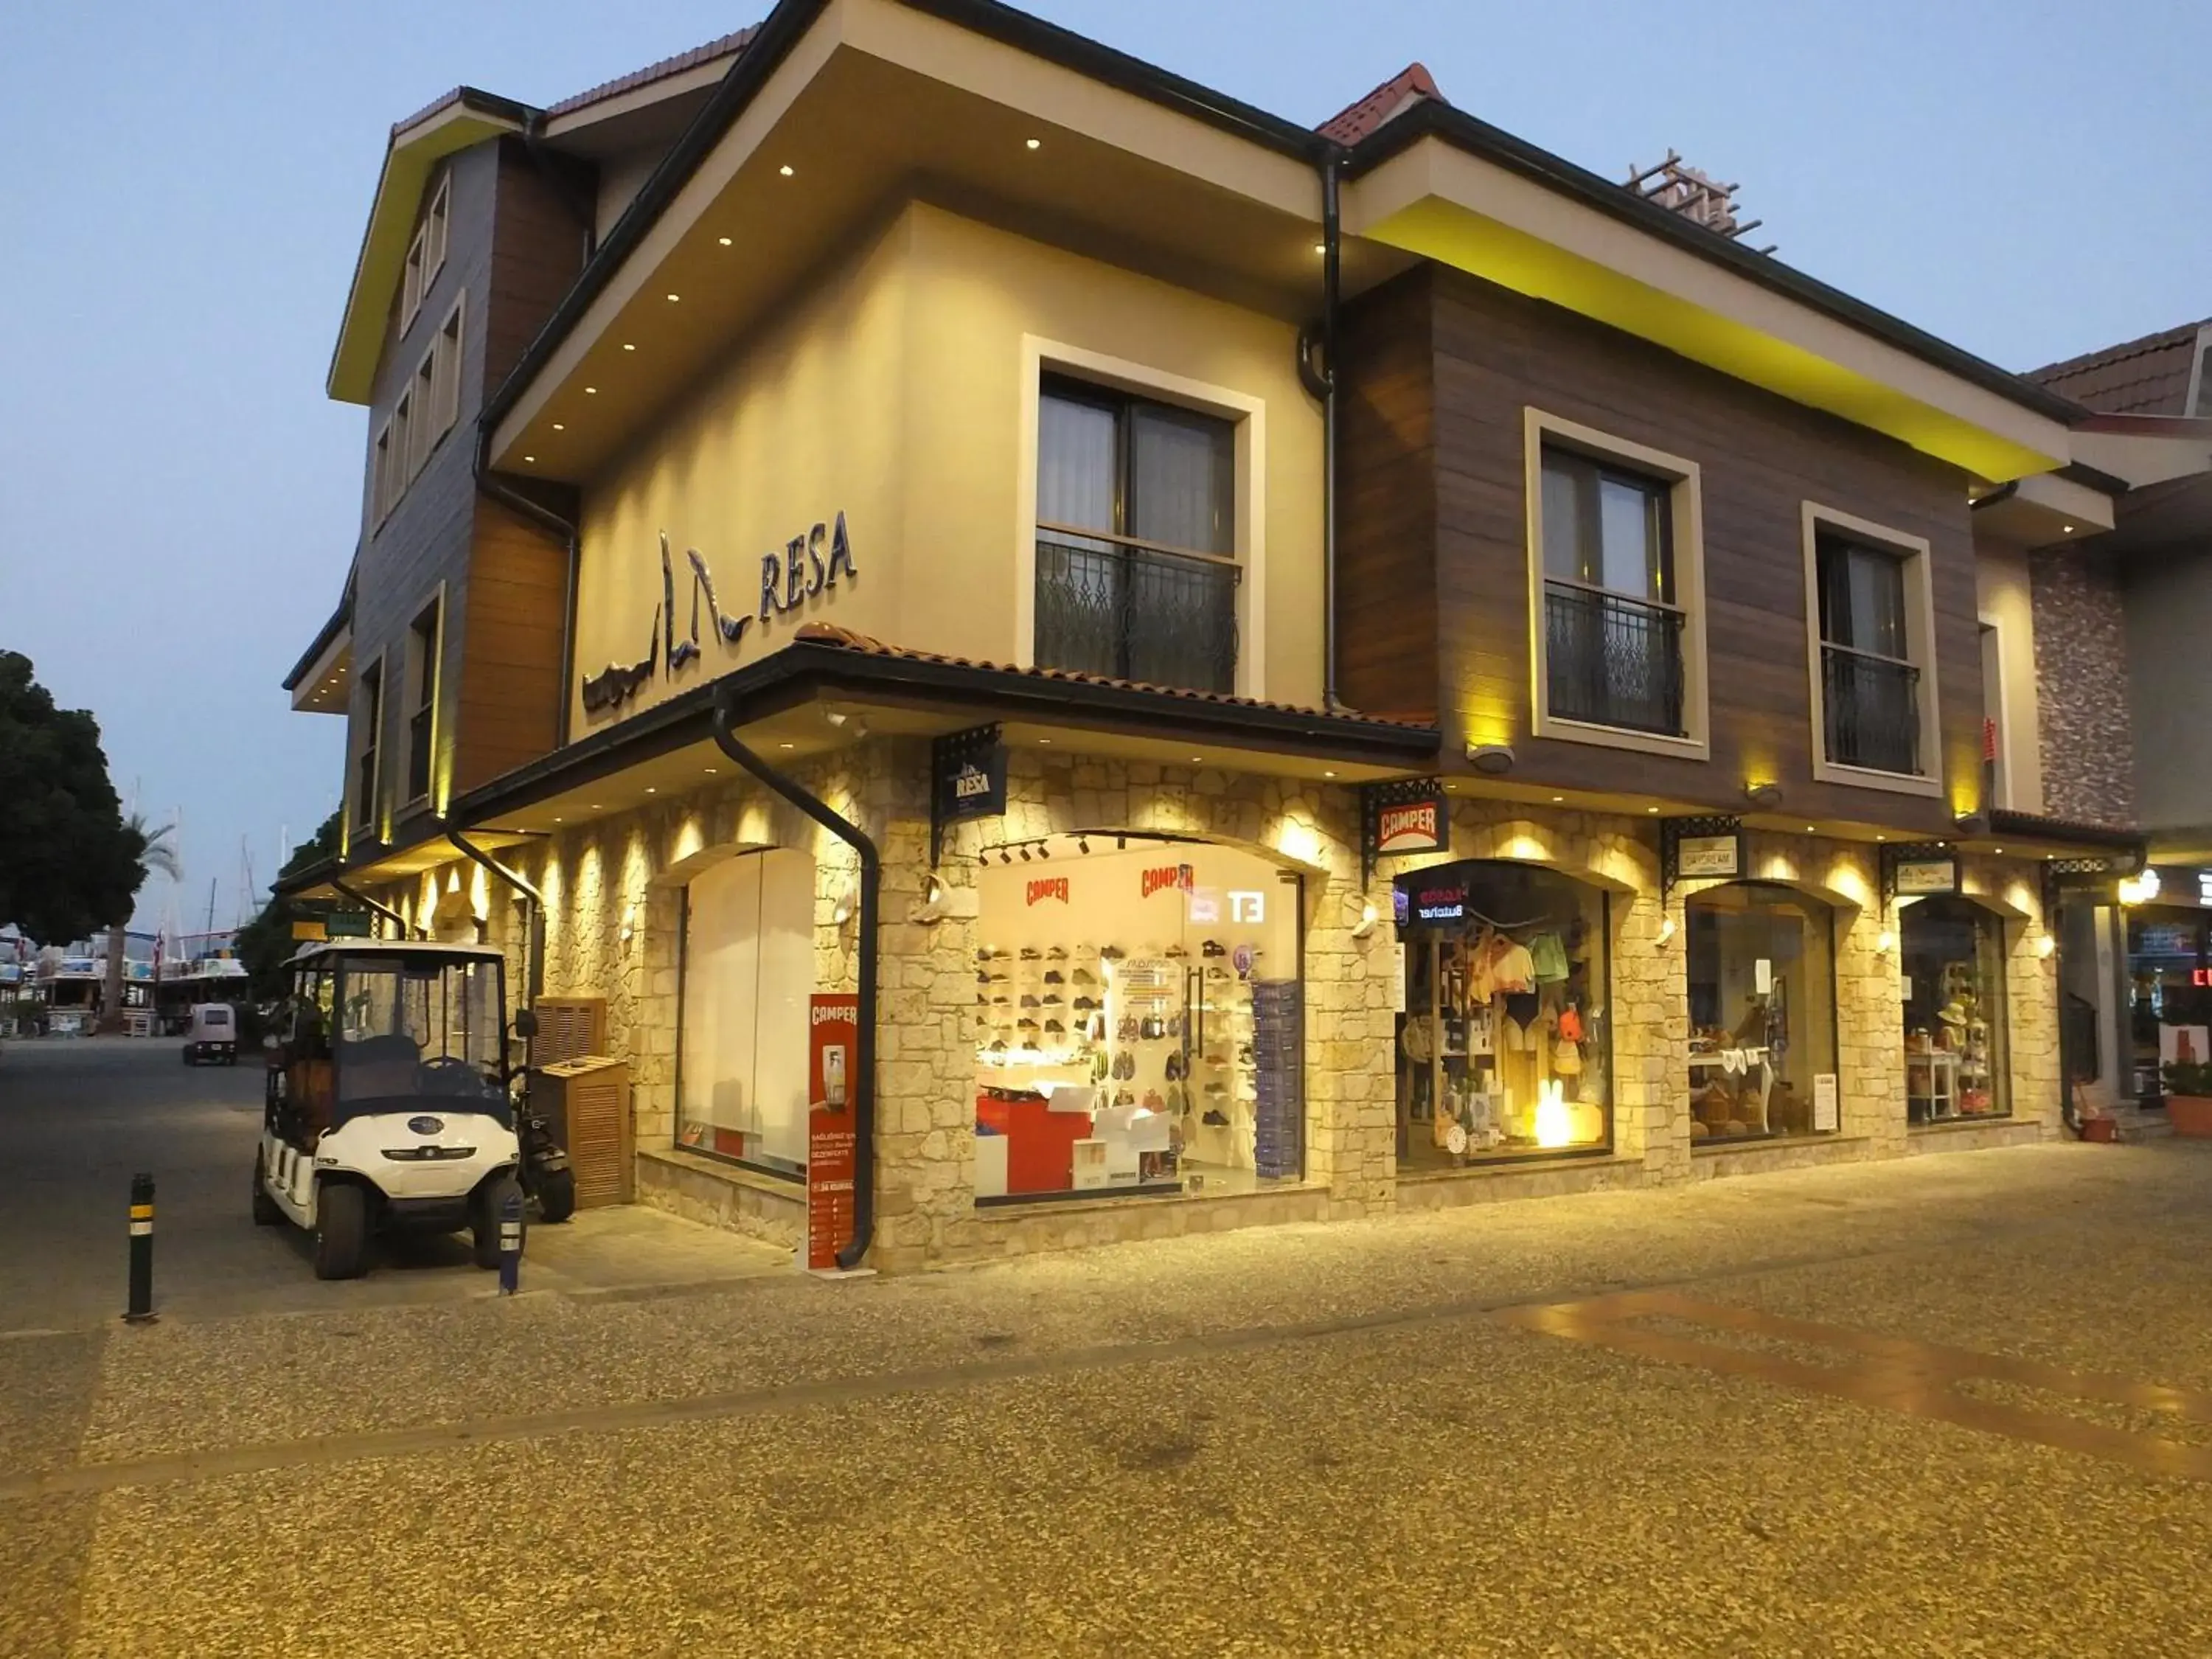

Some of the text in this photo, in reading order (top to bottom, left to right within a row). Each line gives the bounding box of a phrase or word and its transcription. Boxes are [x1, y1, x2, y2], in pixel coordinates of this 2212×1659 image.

[759, 510, 858, 623] RESA
[956, 773, 990, 798] RESA
[1381, 807, 1436, 840] CAMPER
[1026, 877, 1068, 906] CAMPER
[1141, 864, 1194, 899] CAMPER
[812, 1006, 858, 1026] CAMPER
